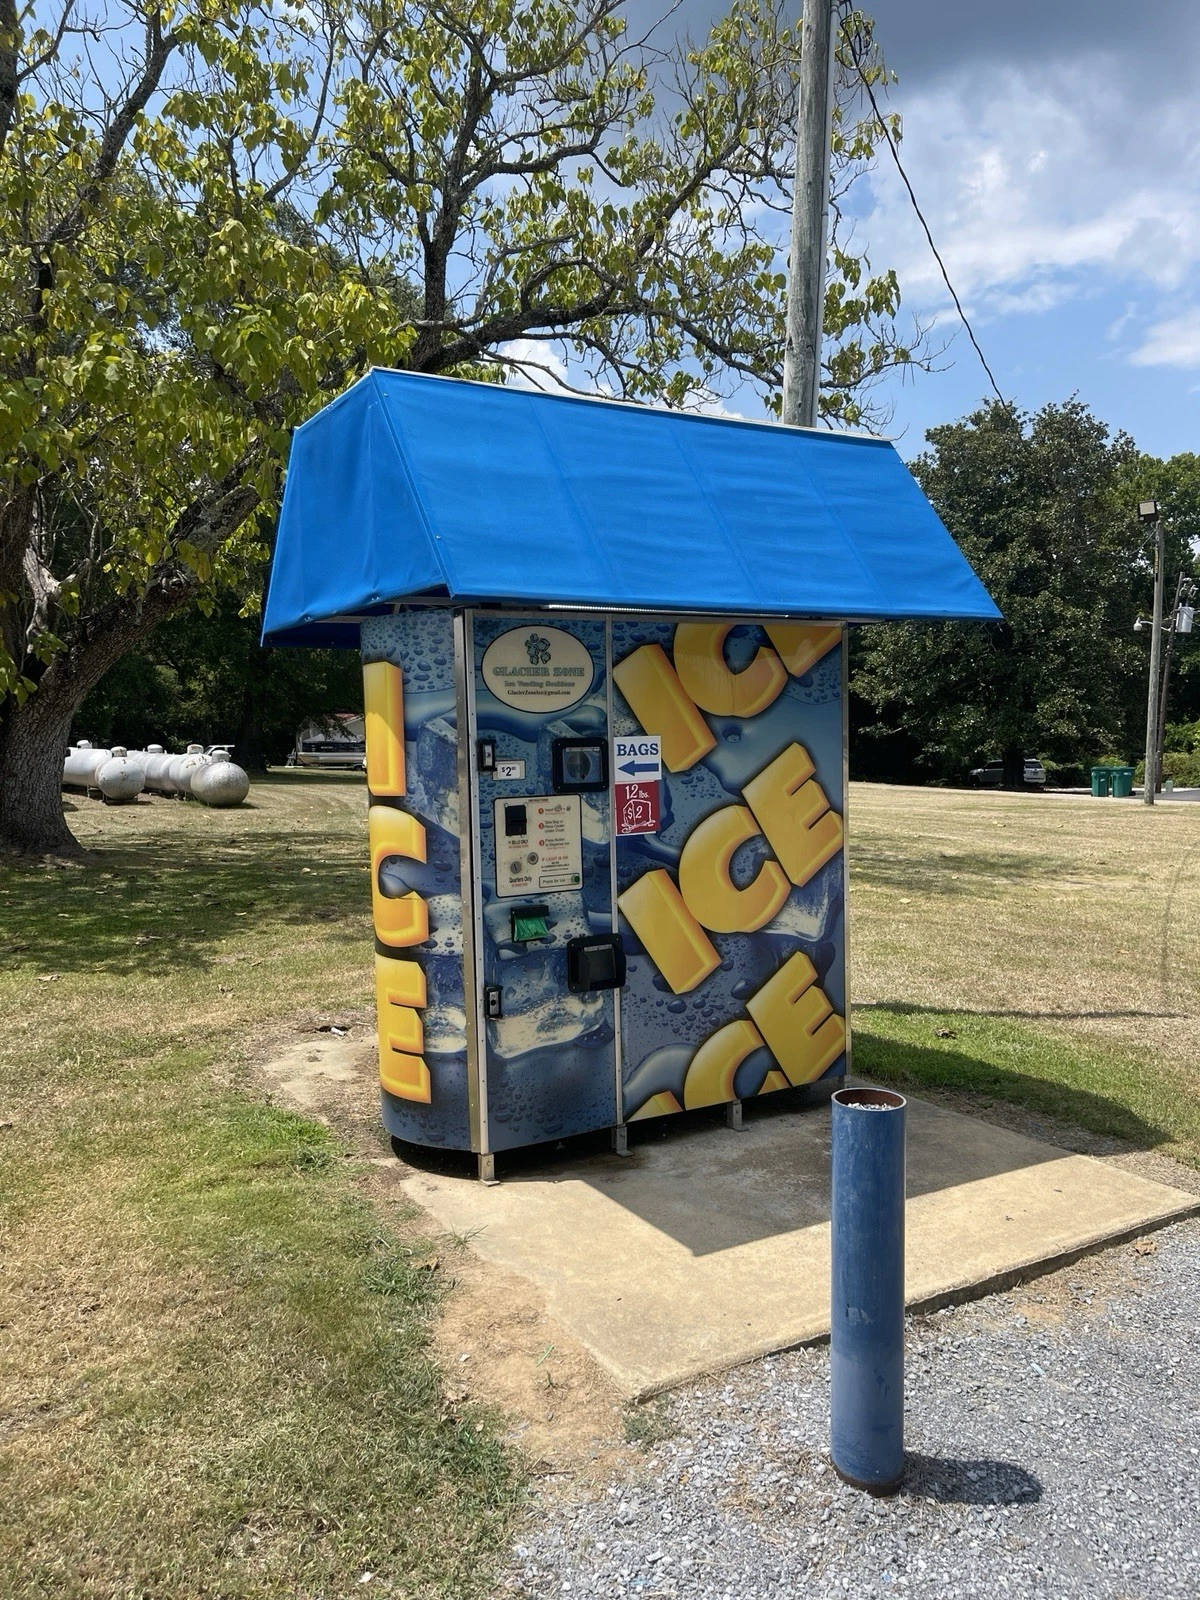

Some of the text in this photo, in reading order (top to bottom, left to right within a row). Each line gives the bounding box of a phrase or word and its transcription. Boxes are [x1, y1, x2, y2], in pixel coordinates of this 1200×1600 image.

[492, 666, 585, 677] GLACIER ZONE
[616, 743, 659, 756] BAGS
[625, 784, 639, 799] 12
[618, 742, 844, 994] ICE
[363, 661, 432, 1104] ICE
